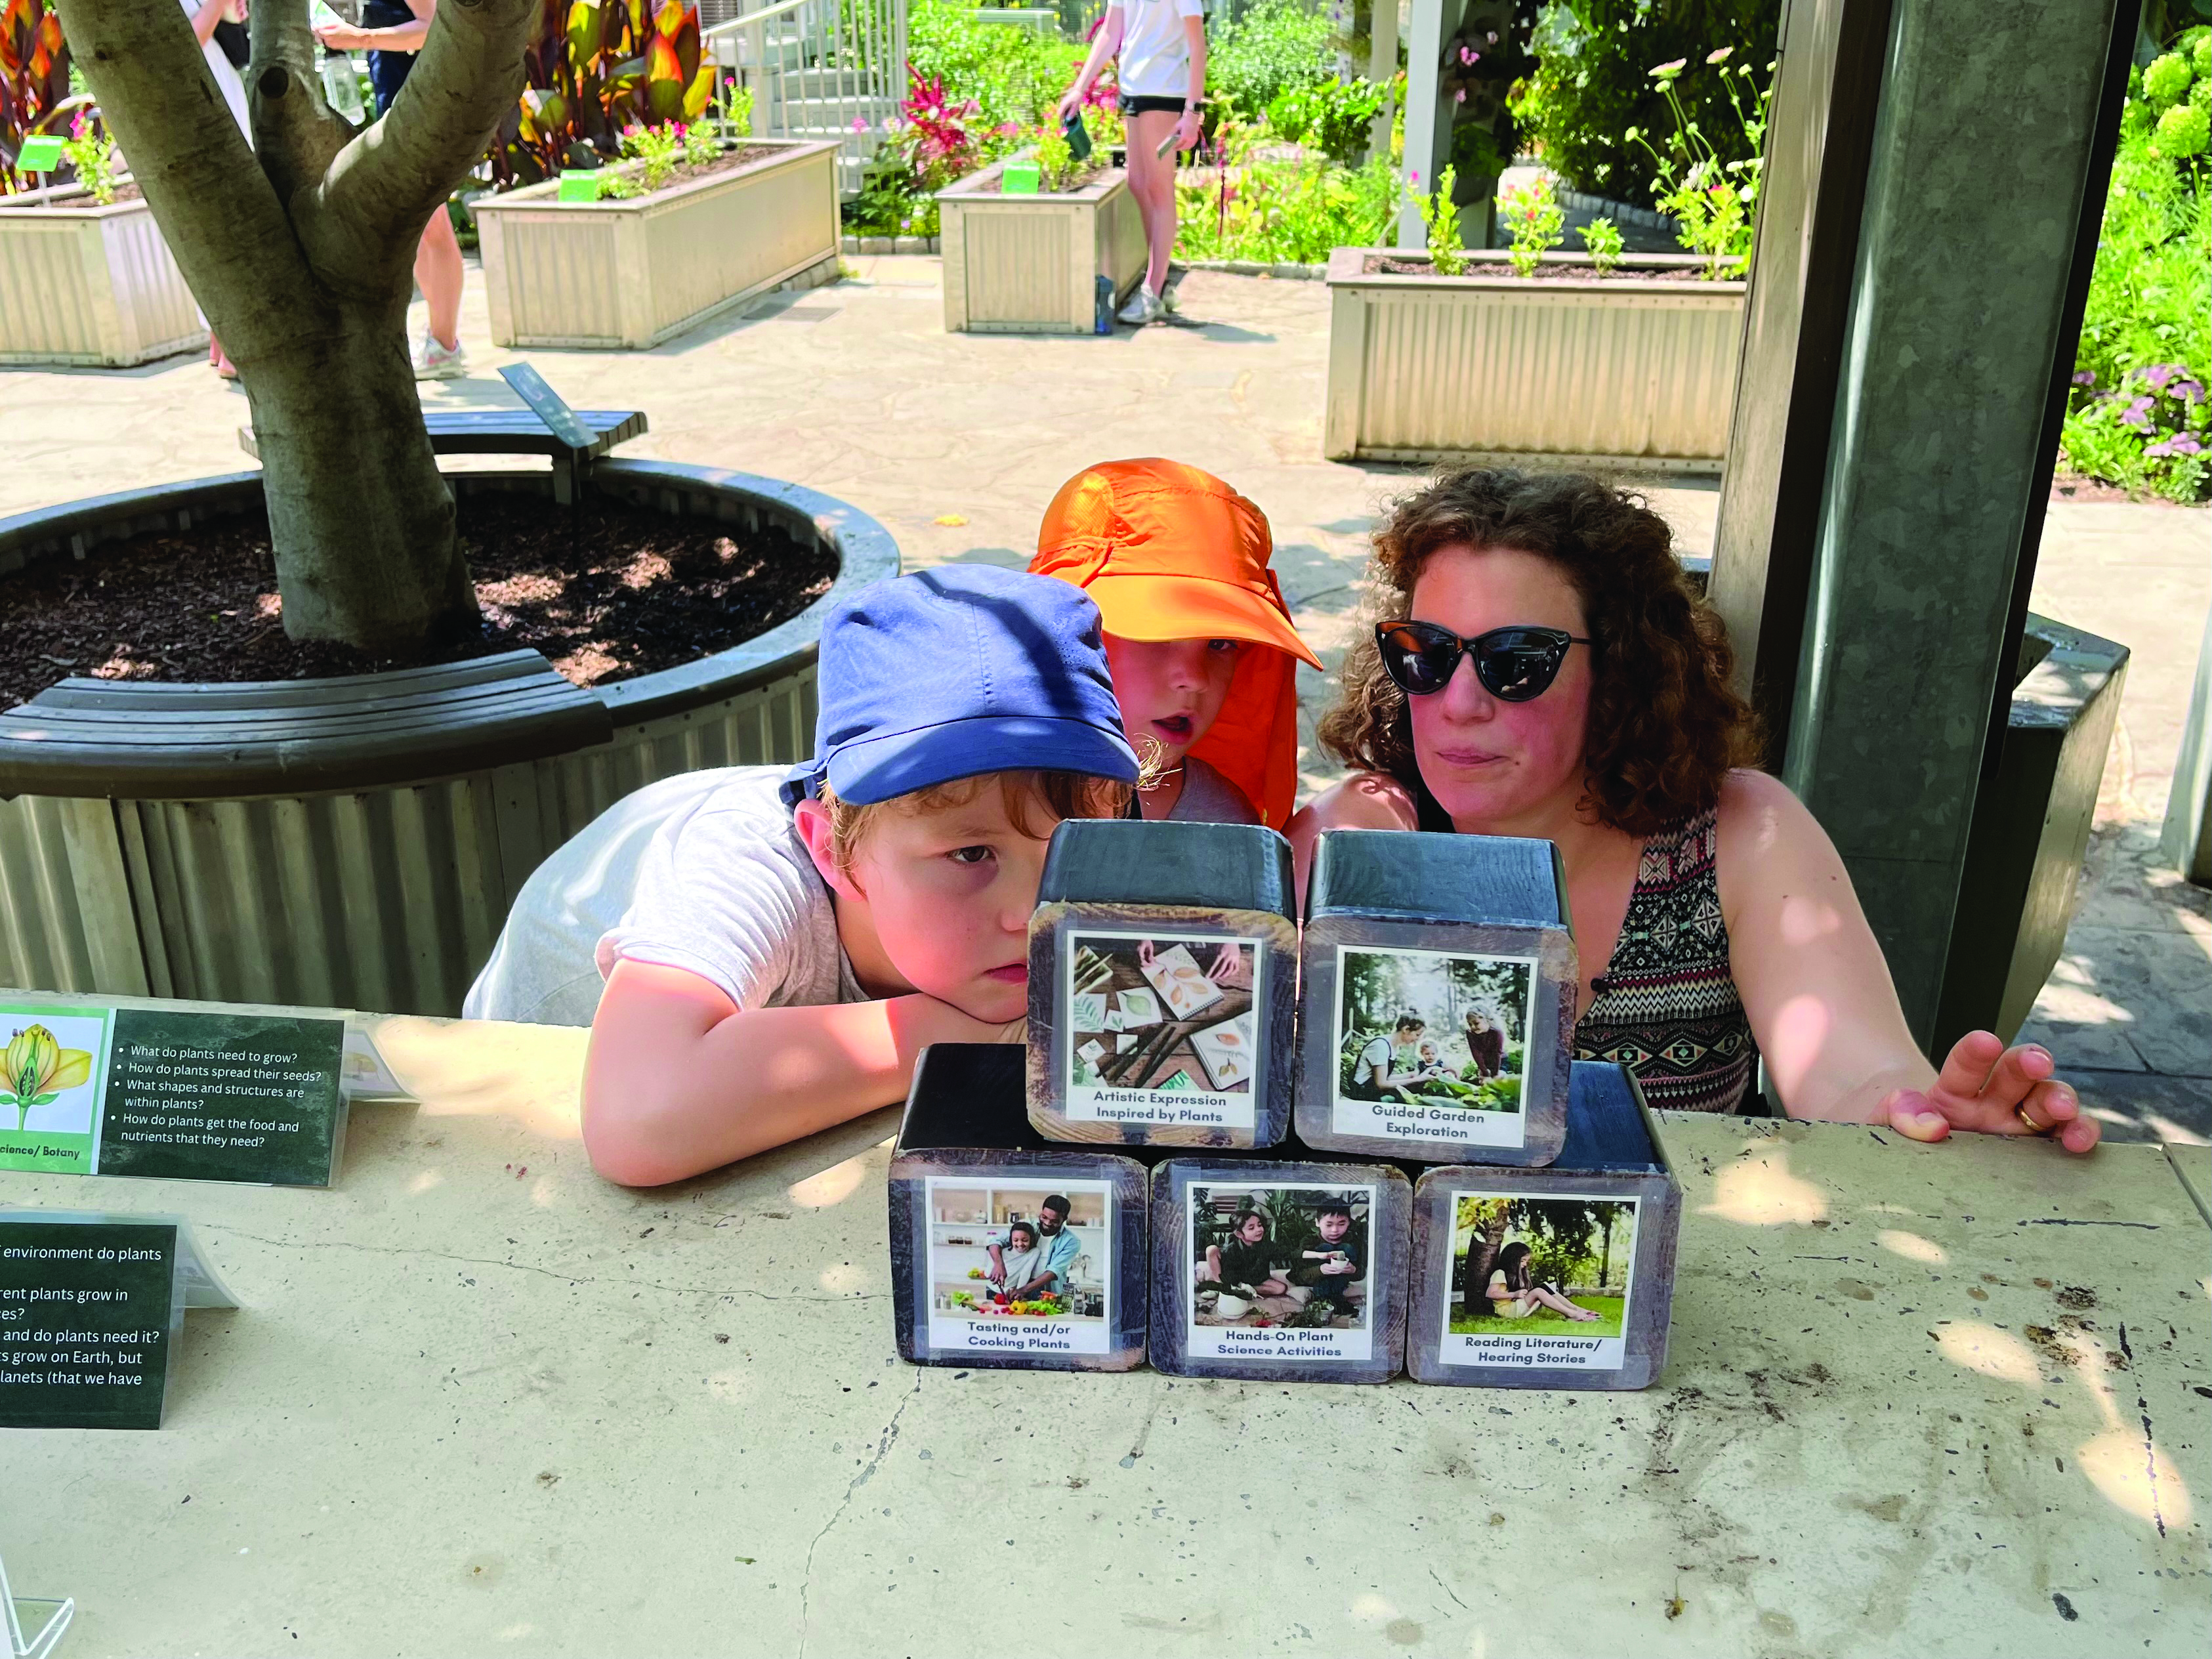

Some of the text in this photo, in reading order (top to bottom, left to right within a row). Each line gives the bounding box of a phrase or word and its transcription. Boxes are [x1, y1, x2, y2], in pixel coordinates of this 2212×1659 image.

[131, 1045, 297, 1066] What do plants need to grow?
[129, 1063, 321, 1082] How do plants spread their seeds?
[127, 1080, 304, 1099] What shapes and structures are
[125, 1096, 204, 1111] within plants?
[1094, 1091, 1226, 1106] Artistic Expression
[1097, 1107, 1222, 1122] Inspired by Plants
[1372, 1105, 1484, 1123] Guided Garden
[123, 1114, 299, 1132] How do plants get the food and
[1387, 1123, 1468, 1137] Exploration
[121, 1131, 264, 1148] nutrients that they need?
[0, 1144, 80, 1160] cience/ Botany
[3, 1246, 161, 1262] environment do plants
[30, 1288, 73, 1302] plants
[77, 1290, 112, 1303] grow
[115, 1289, 128, 1301] in
[0, 1308, 25, 1320] es?
[3, 1329, 159, 1344] and do plants need it?
[967, 1322, 1070, 1336] Tasting and/or
[1226, 1331, 1333, 1341] Hands-On Plant
[969, 1336, 1070, 1349] Cooking Plants
[1465, 1337, 1602, 1351] Reading Literature/
[1218, 1345, 1341, 1356] Science Activities
[1479, 1352, 1585, 1364] Hearing Stories
[12, 1352, 47, 1364] grow
[51, 1353, 68, 1362] on
[73, 1351, 114, 1366] Earth,
[118, 1352, 142, 1364] but
[0, 1371, 142, 1385] lanets (that we have
